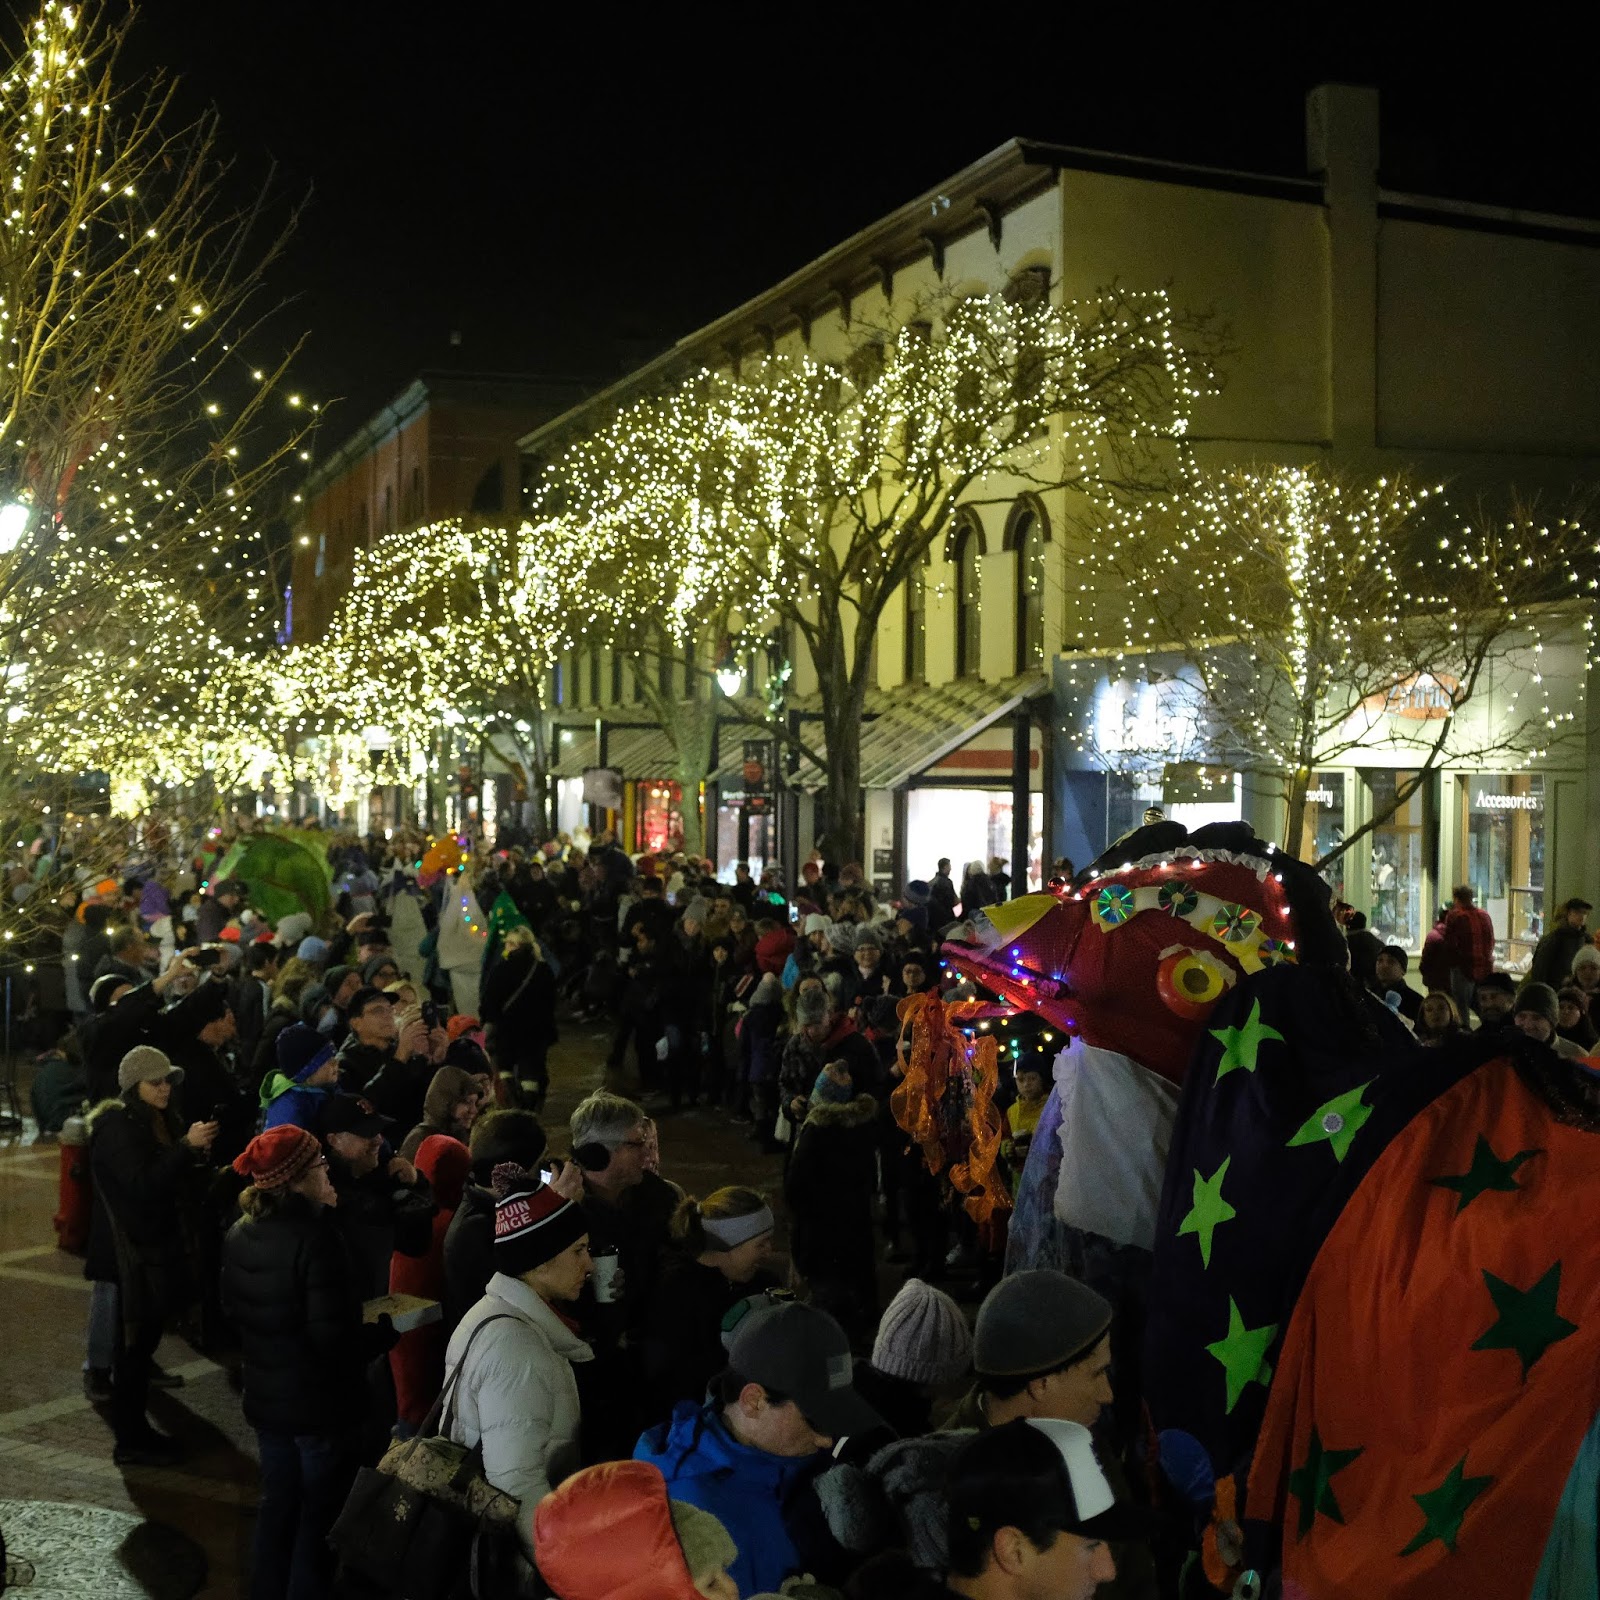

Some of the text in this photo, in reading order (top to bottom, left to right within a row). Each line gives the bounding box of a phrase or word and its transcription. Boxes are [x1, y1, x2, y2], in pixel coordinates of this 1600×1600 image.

[1305, 783, 1334, 808] ewelry
[1475, 788, 1537, 809] Accessories
[495, 1200, 531, 1223] GUIN
